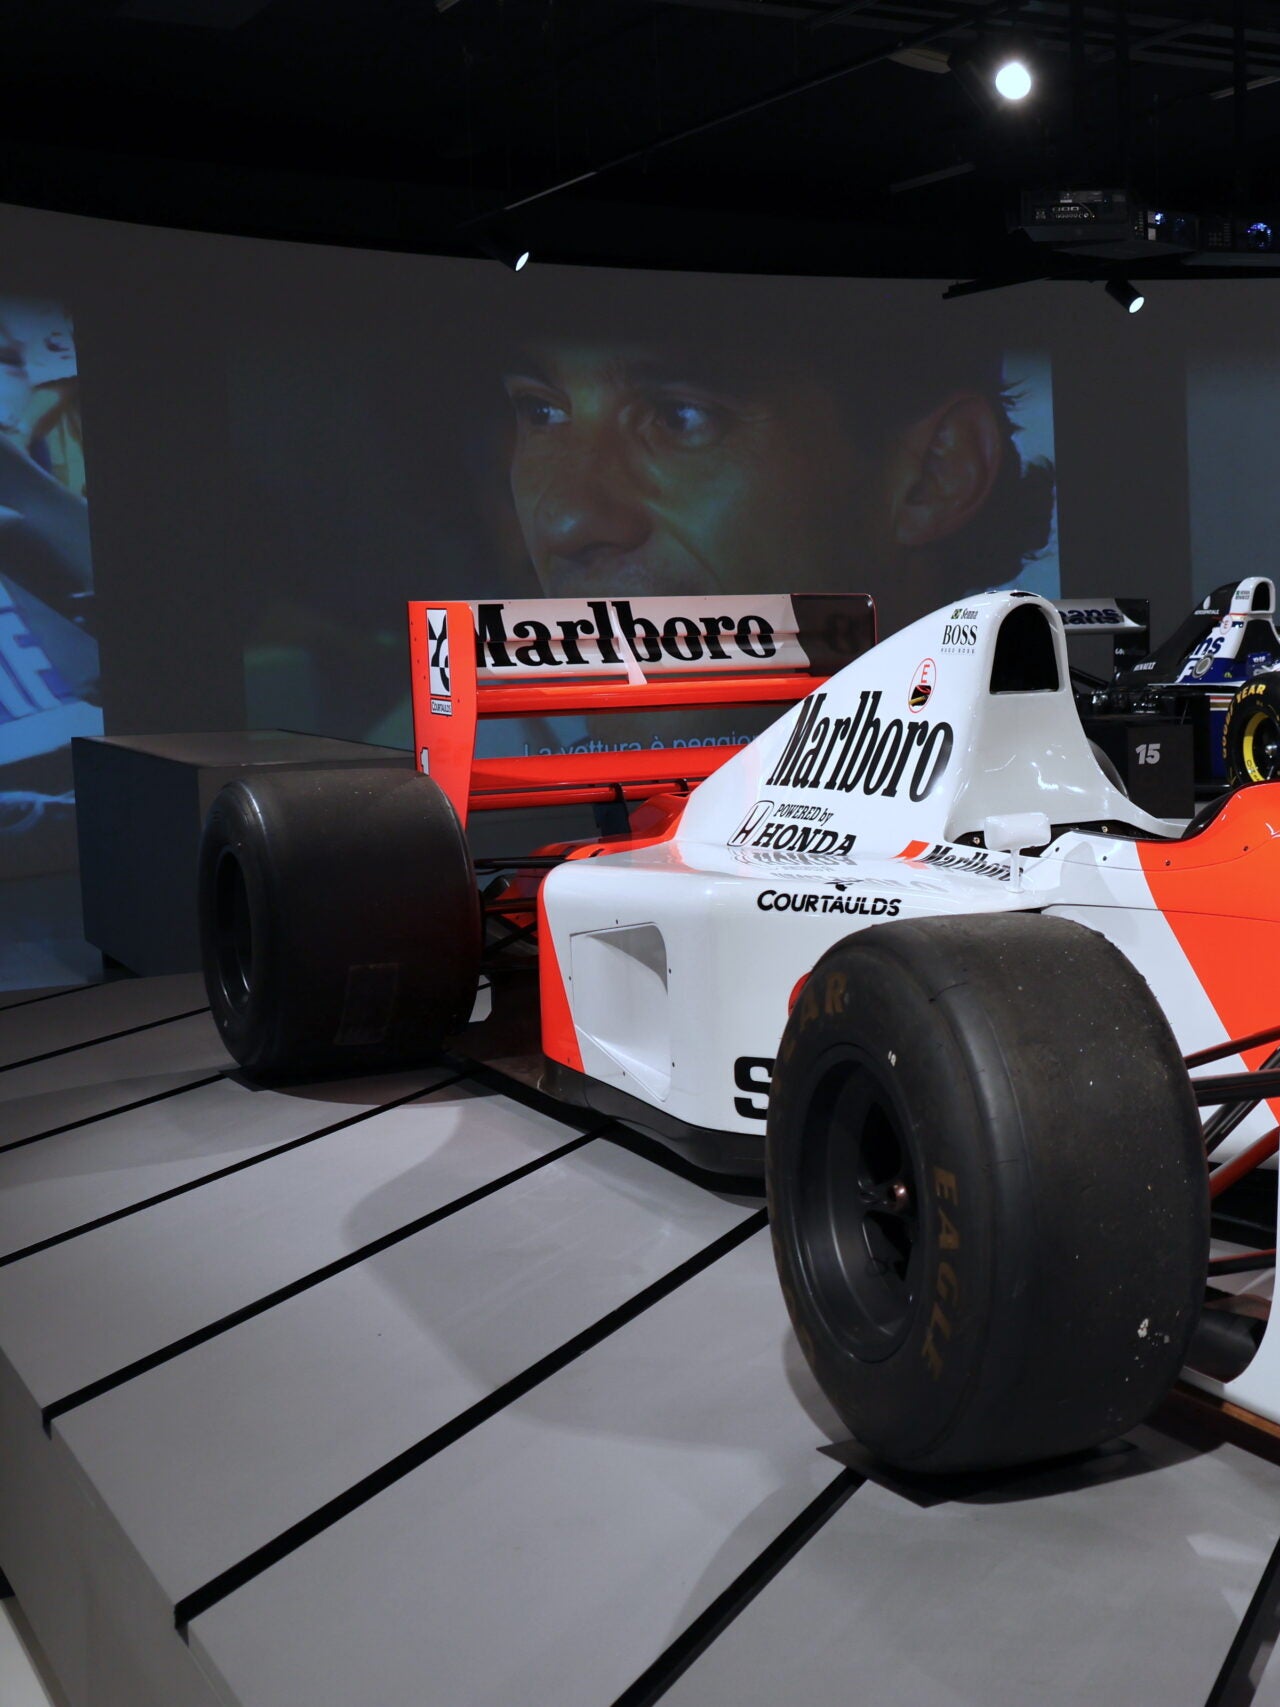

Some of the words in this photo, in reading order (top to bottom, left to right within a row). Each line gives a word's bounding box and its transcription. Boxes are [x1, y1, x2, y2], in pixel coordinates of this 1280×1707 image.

[475, 600, 777, 668] Marlboro
[942, 624, 978, 646] BOSS
[920, 664, 930, 683] E
[673, 731, 758, 749] peggio
[765, 690, 955, 803] Marlboro
[1136, 743, 1161, 765] 15
[774, 803, 823, 822] POWERED
[821, 810, 835, 826] by
[751, 822, 858, 857] HONDA
[914, 844, 1024, 882] Marlbor
[756, 889, 902, 917] COURTAULDS
